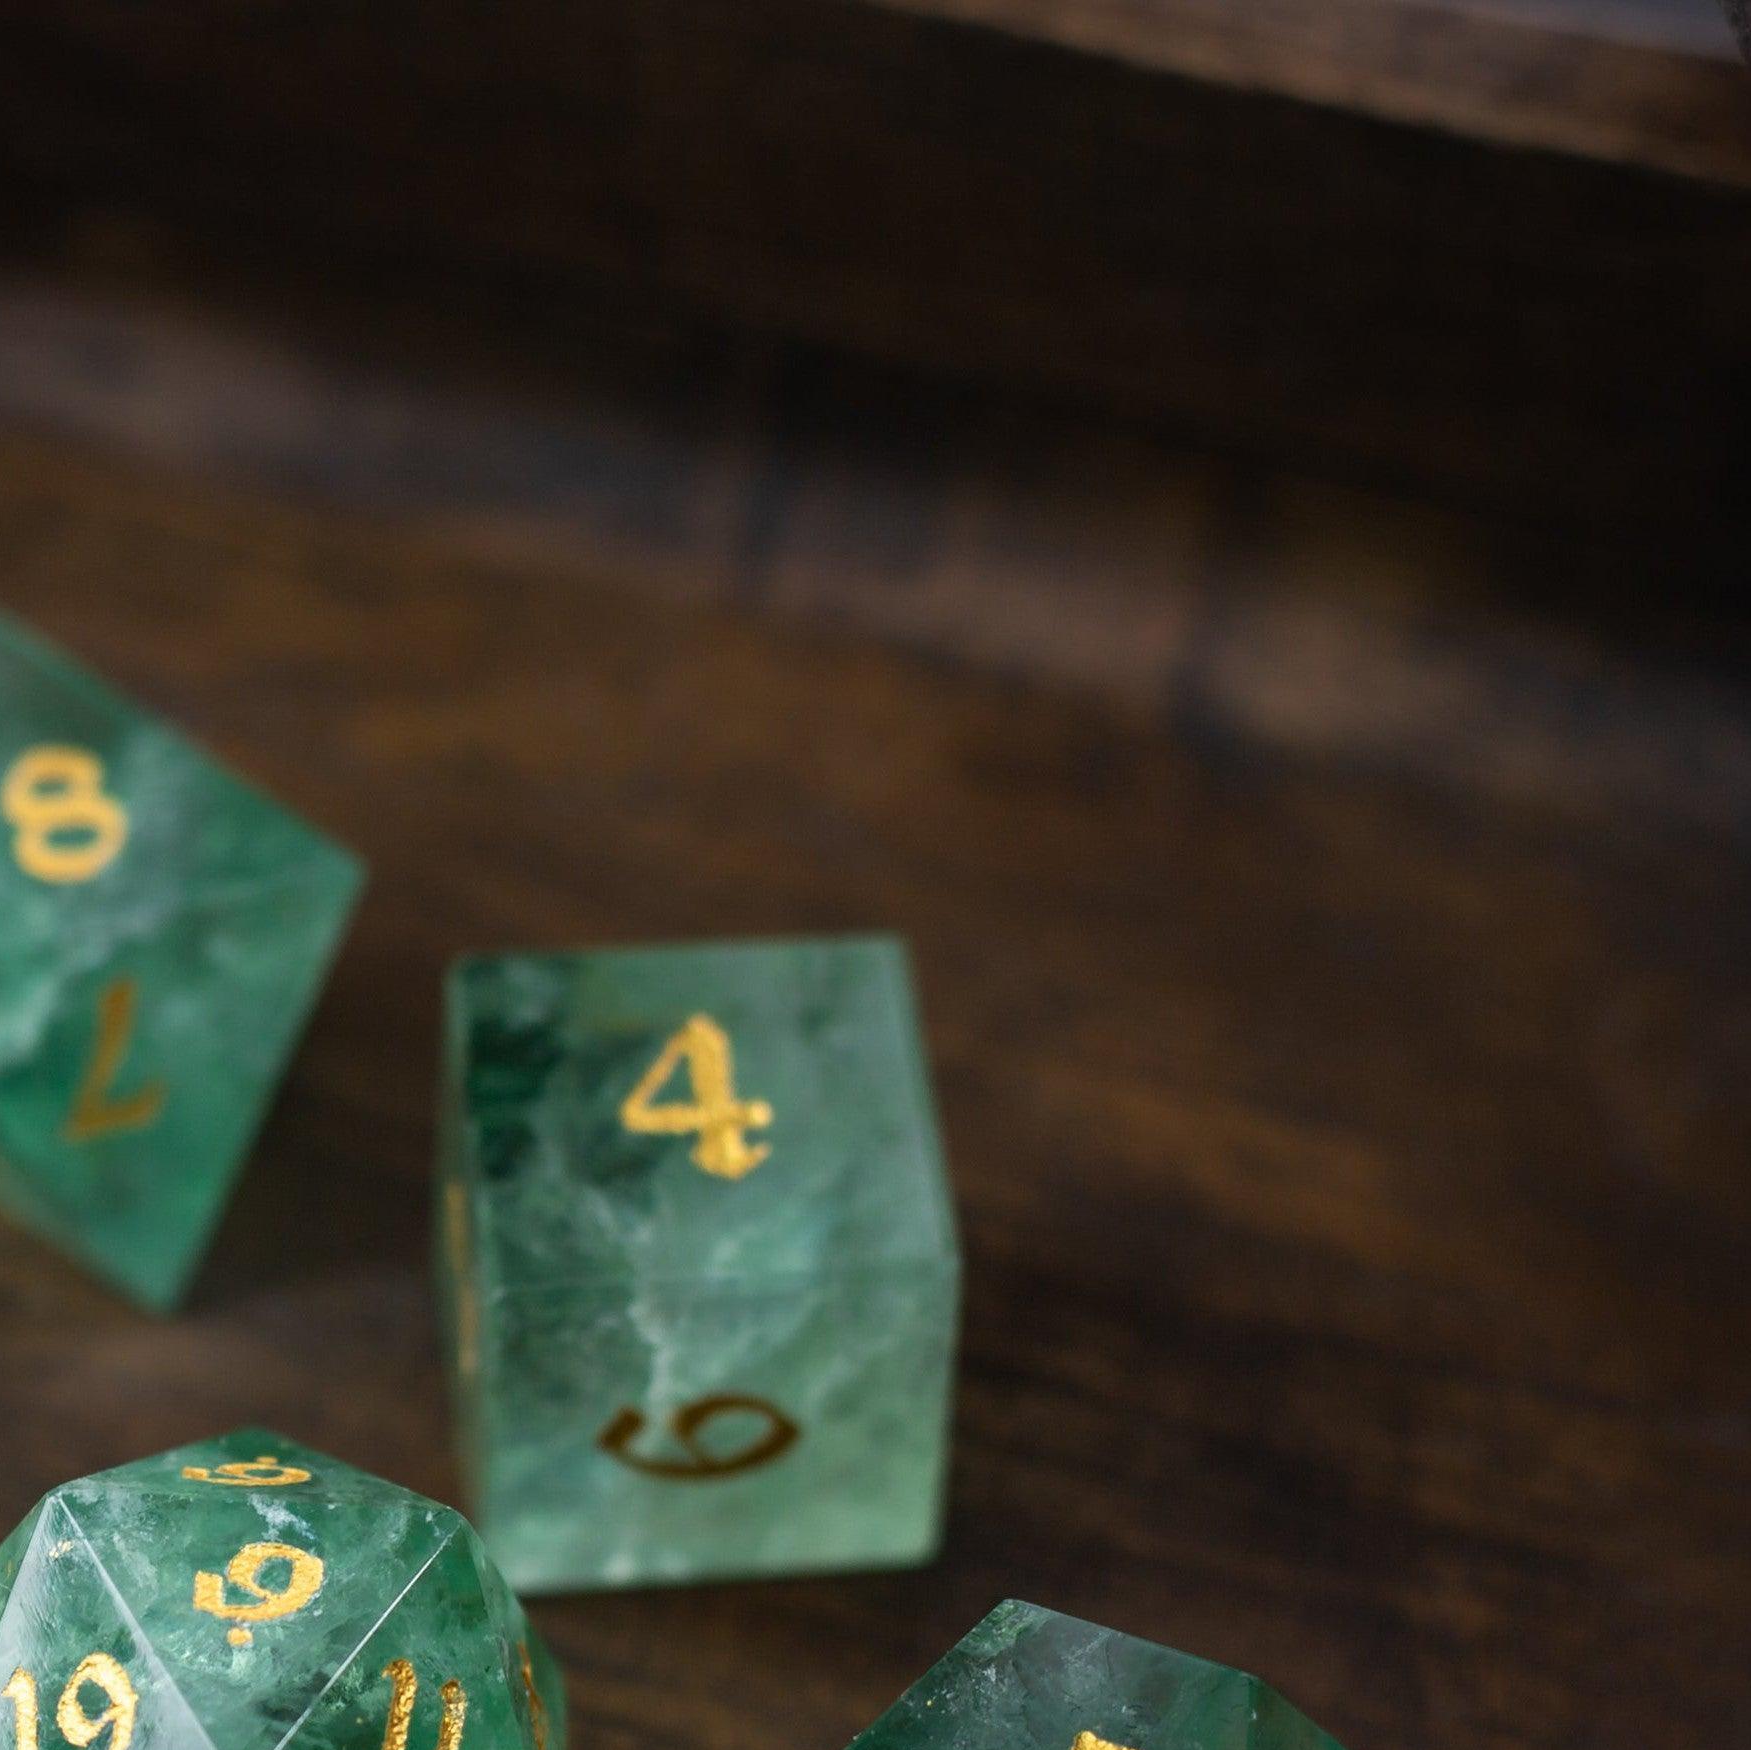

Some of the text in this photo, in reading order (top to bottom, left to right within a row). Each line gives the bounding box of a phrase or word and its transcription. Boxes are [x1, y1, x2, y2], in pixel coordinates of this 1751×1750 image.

[0, 745, 129, 886] 8
[62, 975, 167, 1143] 7
[620, 1014, 774, 1180] 4
